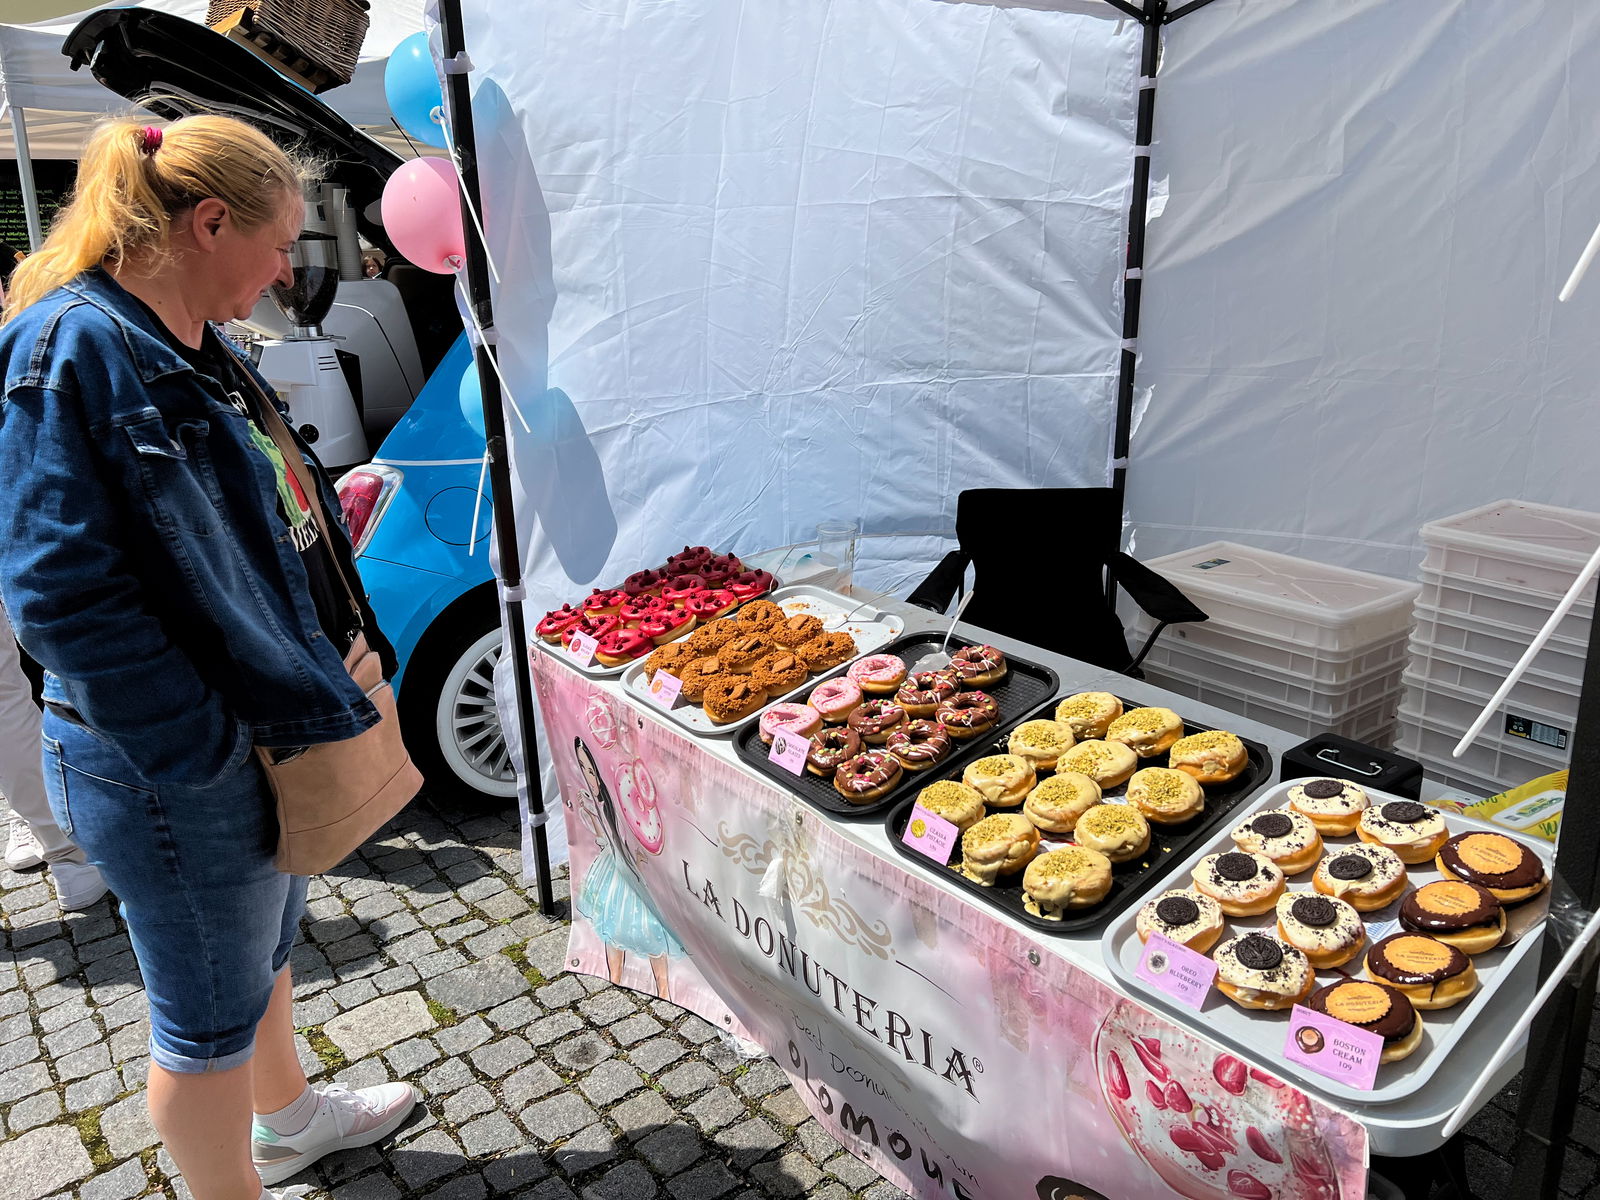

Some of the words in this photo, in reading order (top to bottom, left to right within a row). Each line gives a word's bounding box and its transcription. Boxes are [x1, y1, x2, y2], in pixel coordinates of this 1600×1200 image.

[682, 859, 727, 923] LA
[1169, 969, 1204, 989] BLUEBERRY
[1333, 1039, 1366, 1056] BOSTON
[1332, 1049, 1362, 1065] CREAM
[1339, 1061, 1352, 1071] 109
